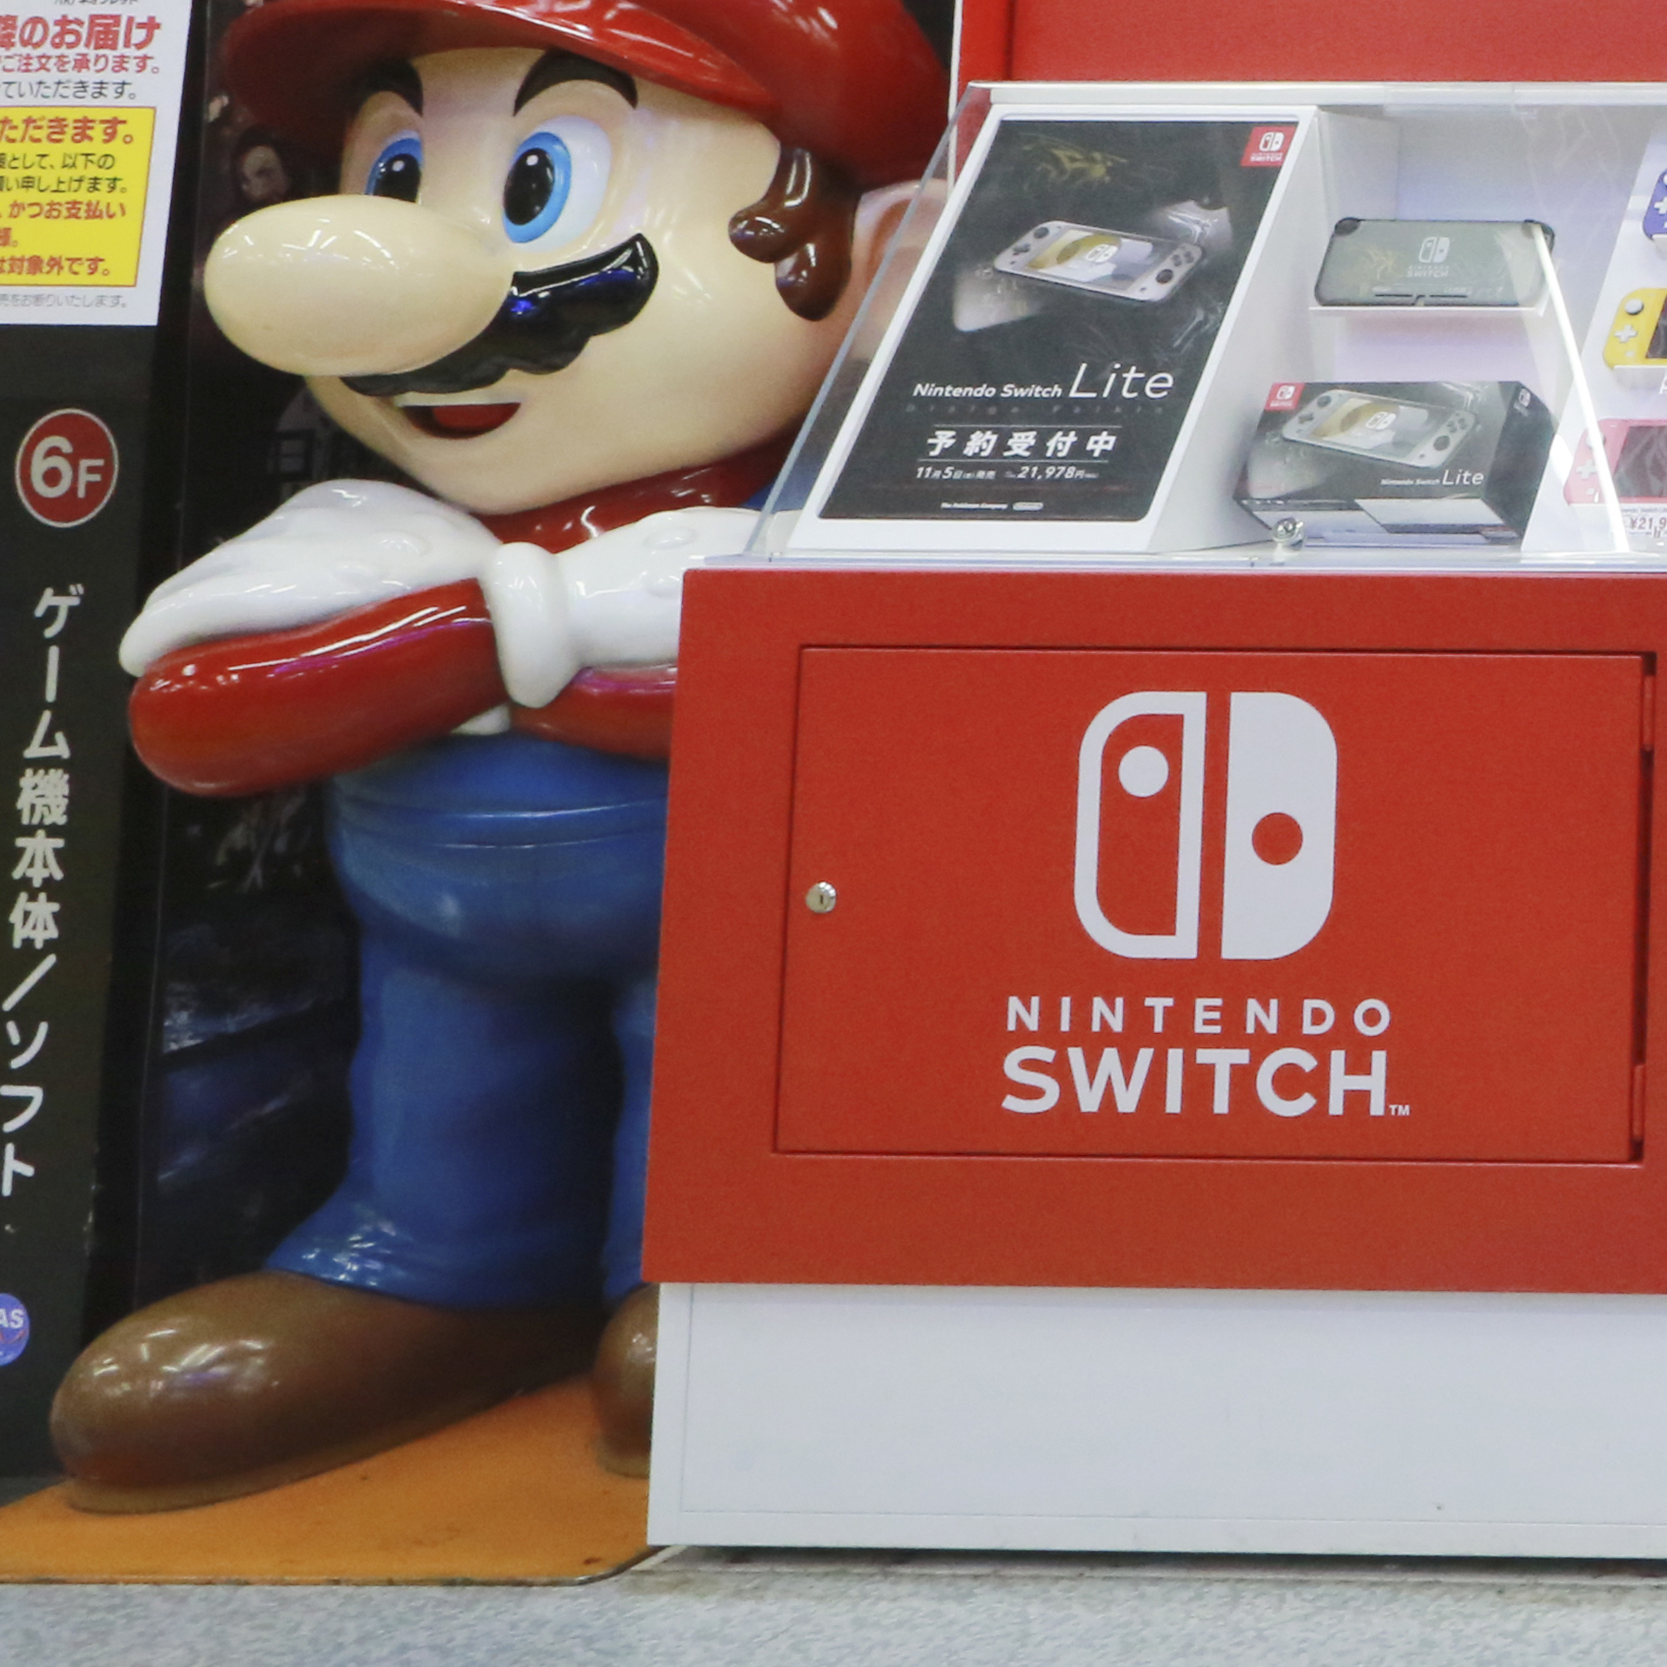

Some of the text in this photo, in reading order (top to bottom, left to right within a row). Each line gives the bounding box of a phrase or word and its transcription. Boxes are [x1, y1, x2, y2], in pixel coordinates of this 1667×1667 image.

[0, 53, 160, 75] ご注文を承ります。
[912, 362, 1174, 399] Nintendo Switch Lite
[926, 429, 1117, 458] 予約受付中
[30, 435, 105, 499] 6F
[1441, 469, 1484, 486] Lite
[1007, 995, 1391, 1037] NINTENDO
